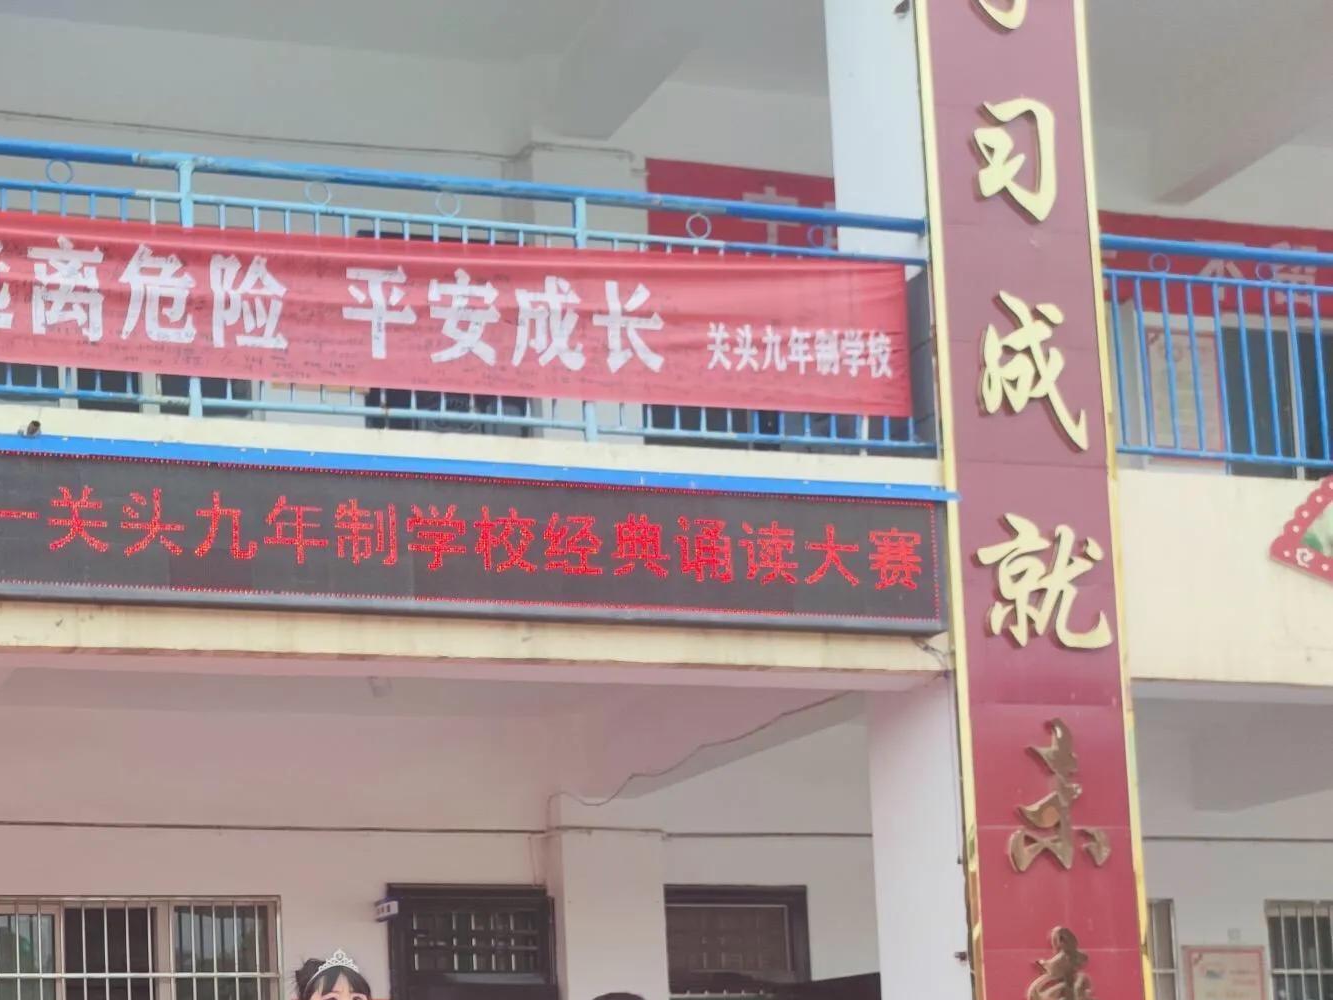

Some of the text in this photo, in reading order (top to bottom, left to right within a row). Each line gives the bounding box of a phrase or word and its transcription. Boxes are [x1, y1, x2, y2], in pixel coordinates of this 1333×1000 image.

[343, 263, 665, 373] 平安成长
[706, 322, 893, 380] 关头九年制学校
